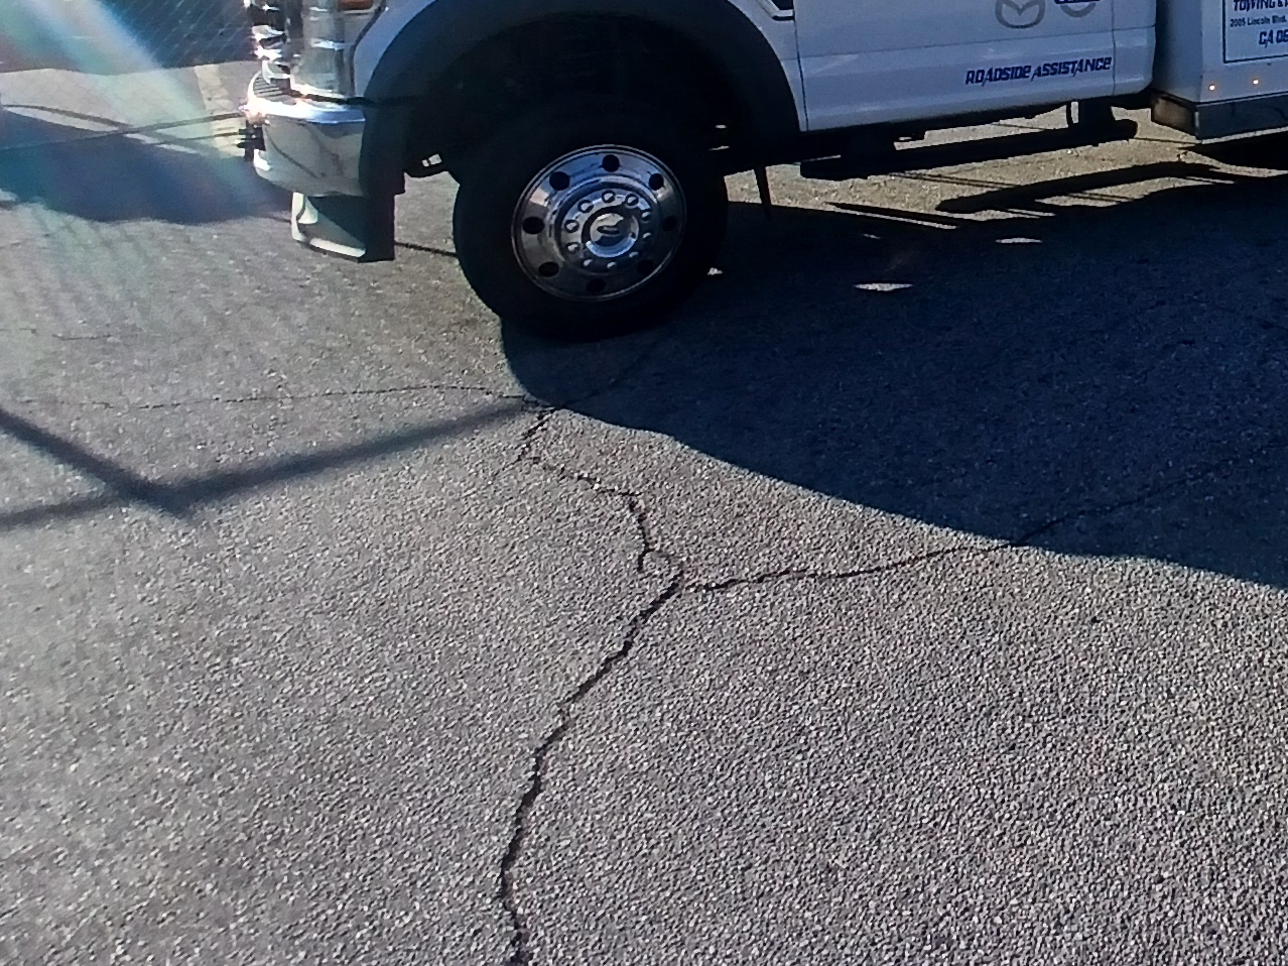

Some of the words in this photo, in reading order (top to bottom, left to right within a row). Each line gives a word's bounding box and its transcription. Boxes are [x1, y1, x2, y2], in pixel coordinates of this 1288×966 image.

[1259, 30, 1274, 48] CA
[965, 65, 1032, 86] ROADSIDE
[1031, 56, 1113, 82] ASSISTANCE
